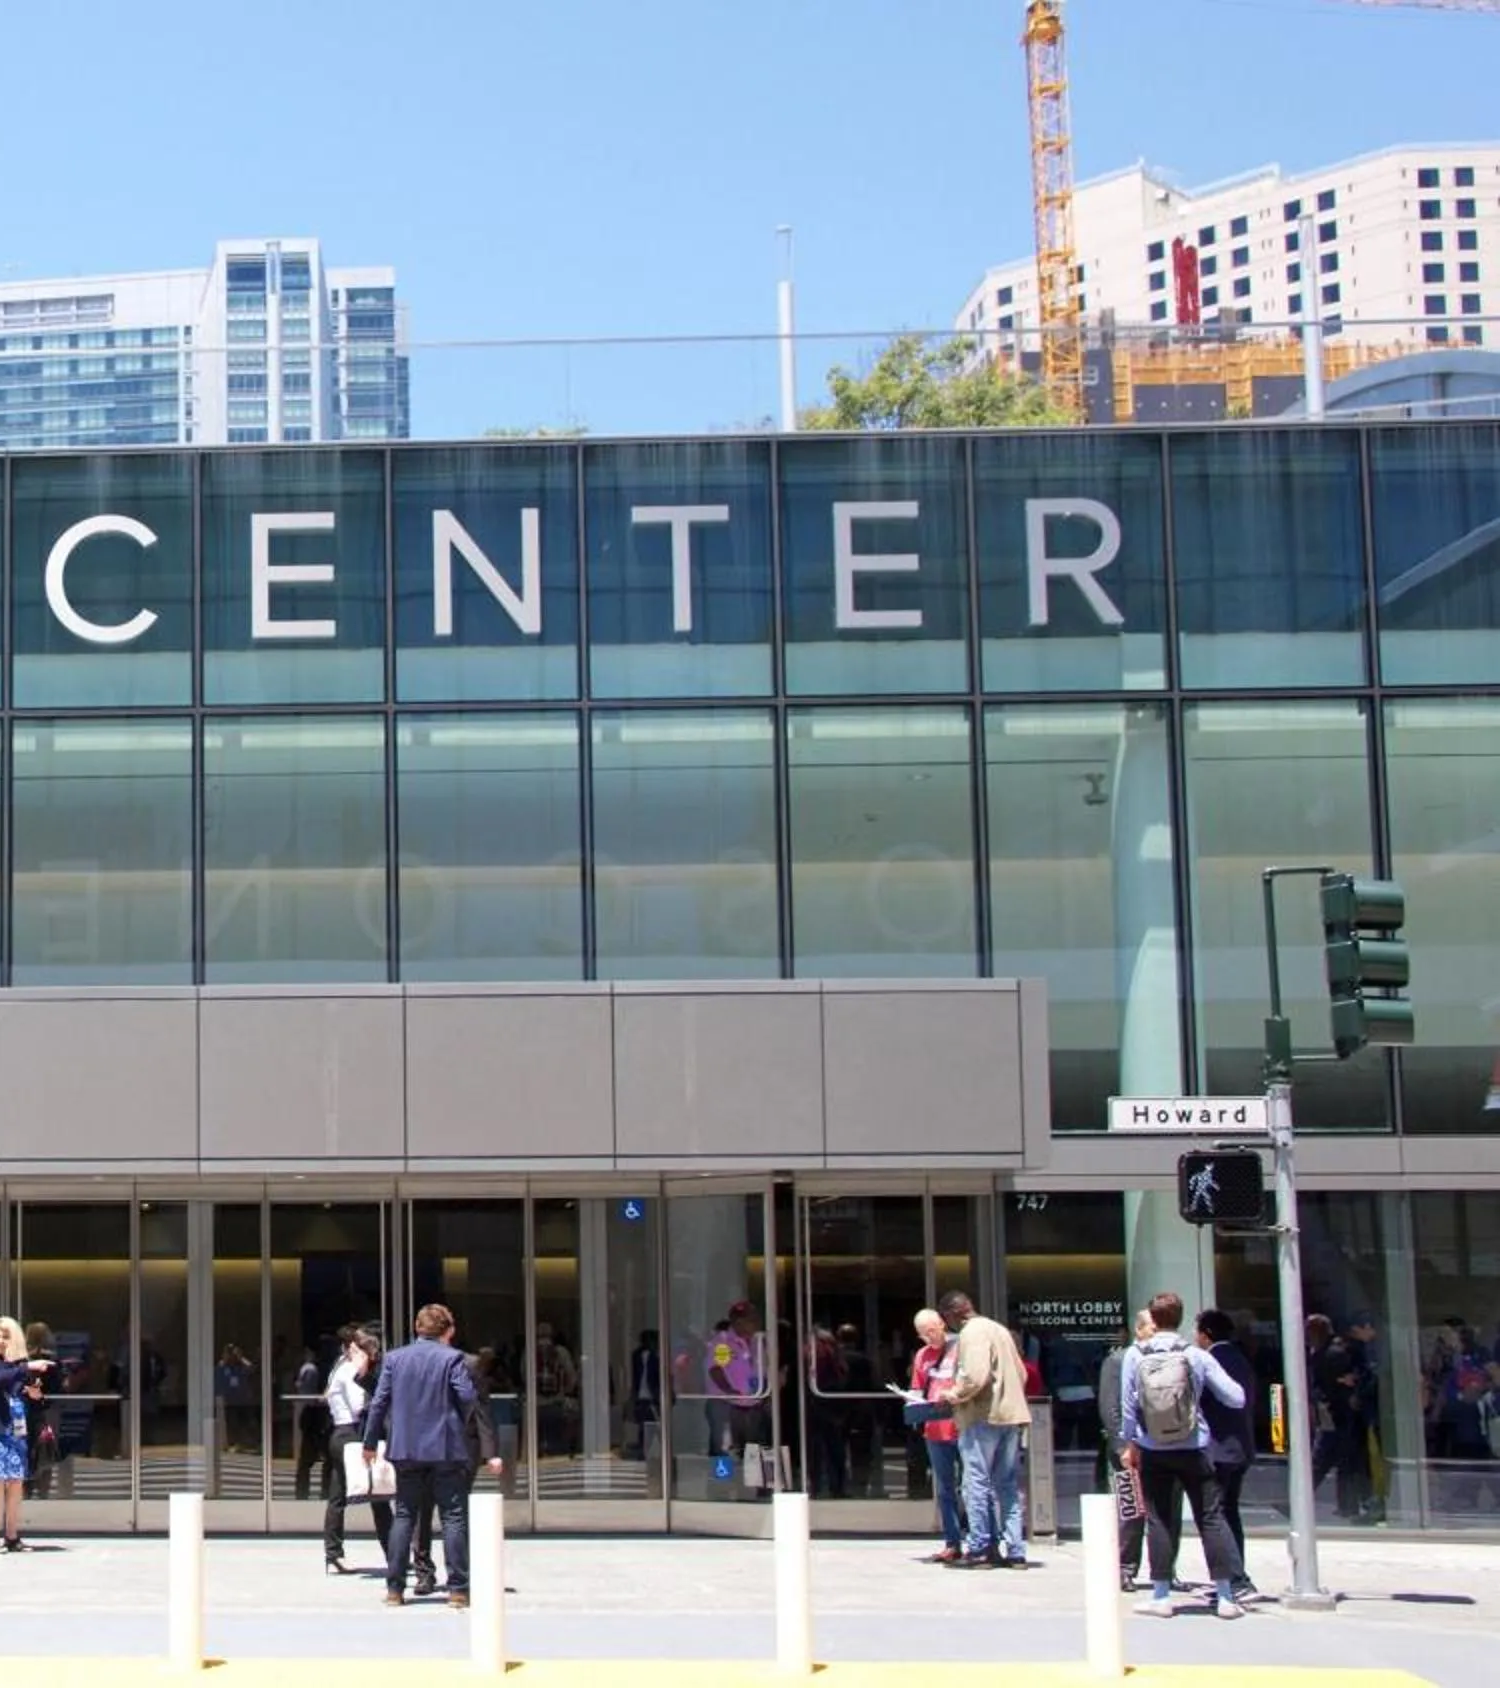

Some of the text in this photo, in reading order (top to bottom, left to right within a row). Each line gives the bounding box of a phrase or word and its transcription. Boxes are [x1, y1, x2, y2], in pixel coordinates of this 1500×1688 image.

[44, 497, 1125, 644] CENTER
[1133, 1105, 1247, 1124] Howard
[1016, 1193, 1049, 1211] 747
[1019, 1302, 1123, 1314] NORTH LOBBY
[1079, 1315, 1124, 1325] CENTER
[1116, 1472, 1137, 1517] 2020
